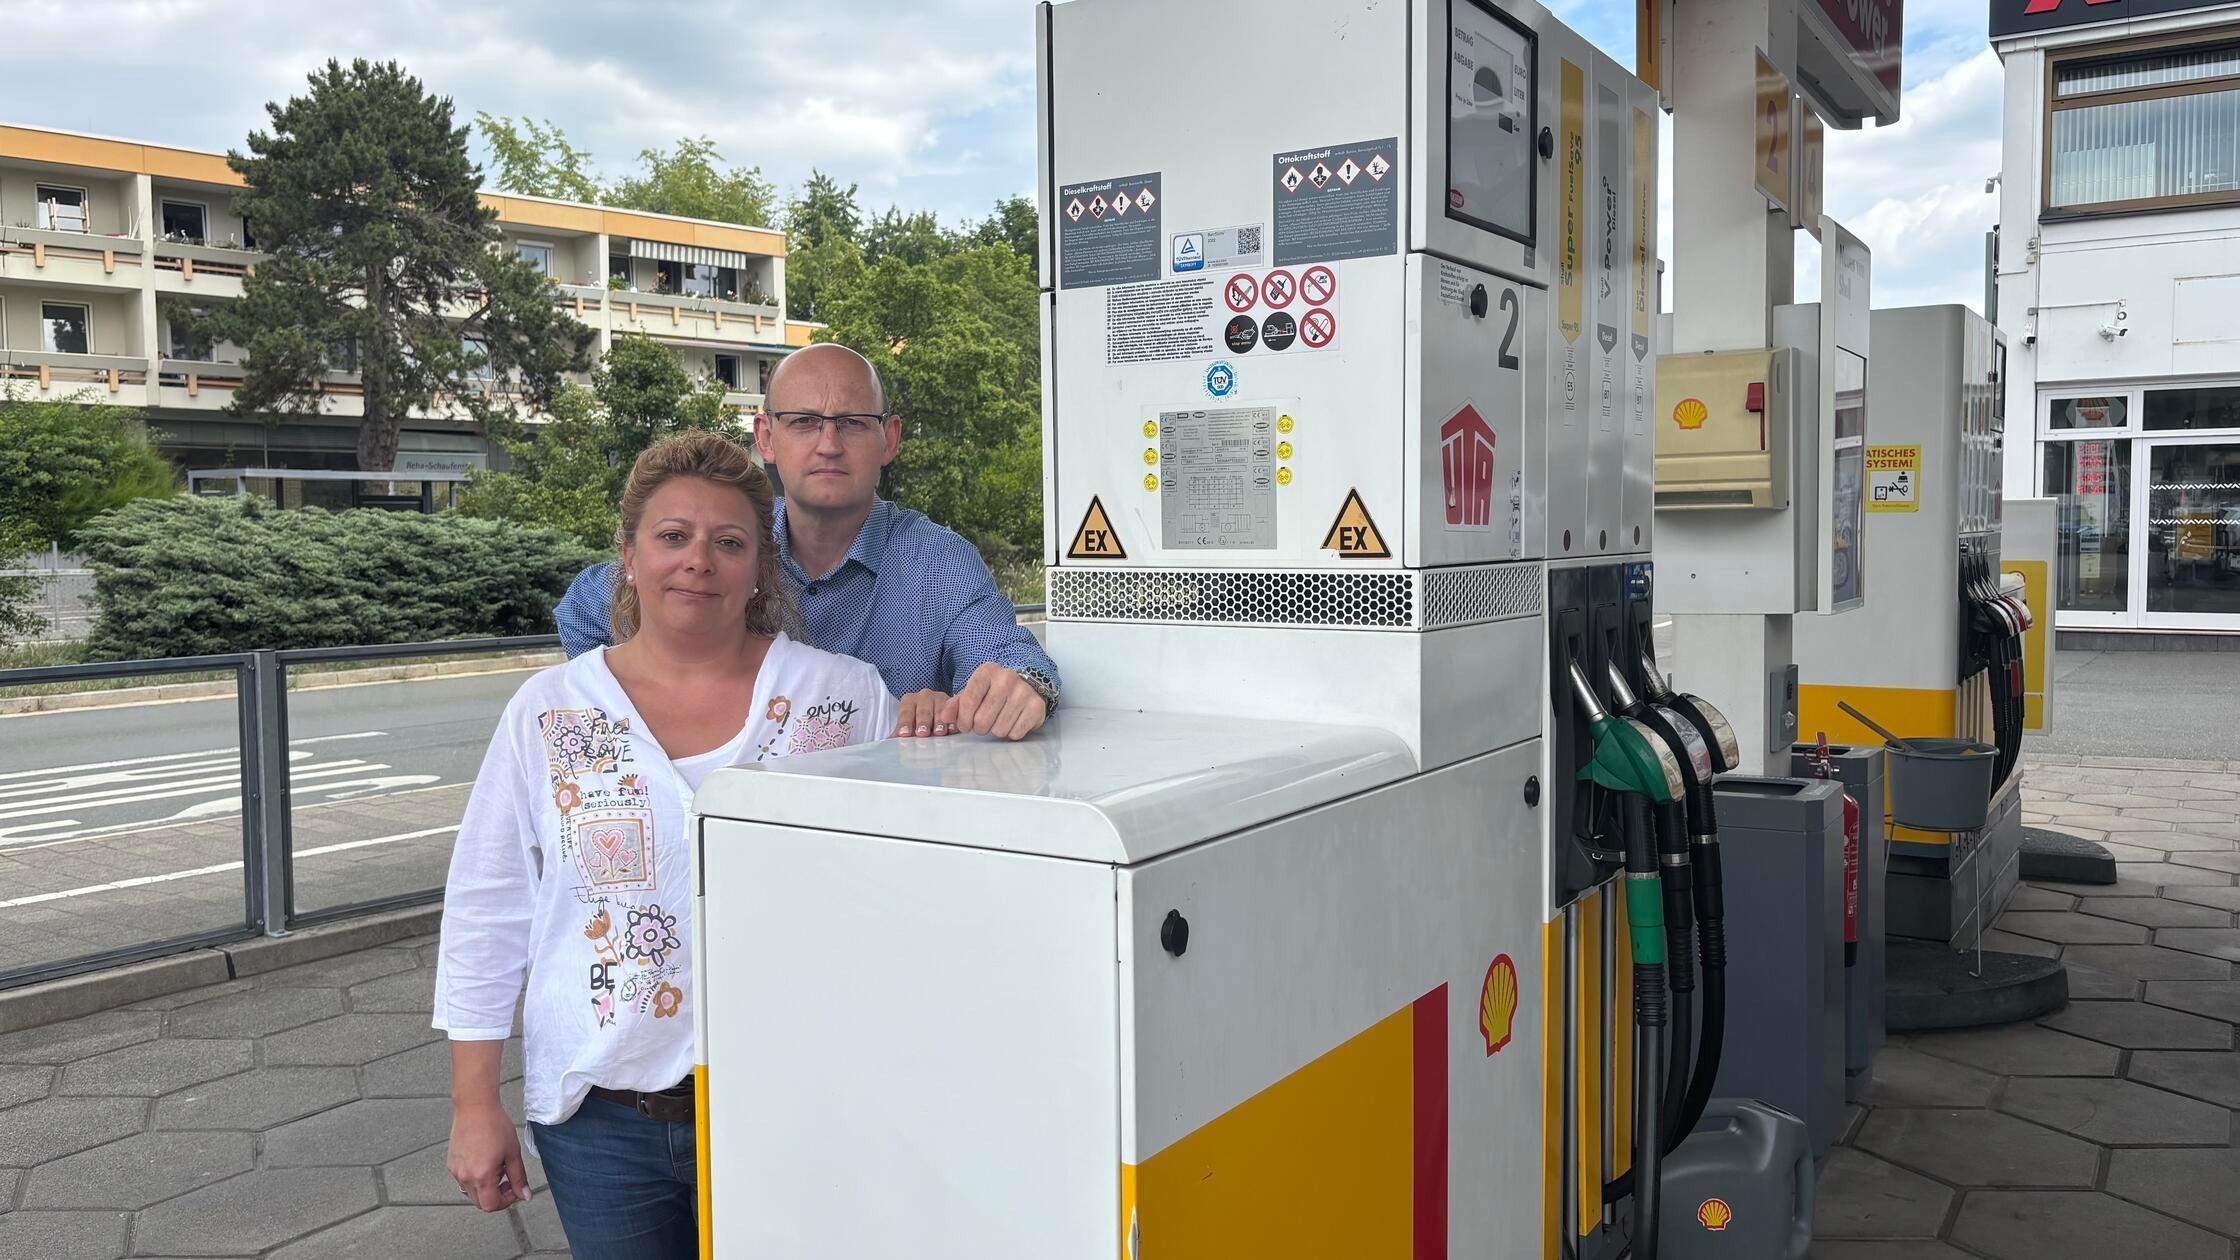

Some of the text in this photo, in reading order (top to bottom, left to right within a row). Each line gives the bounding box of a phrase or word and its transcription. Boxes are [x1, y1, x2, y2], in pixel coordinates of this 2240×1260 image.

[1454, 27, 1474, 47] BETRAG
[1454, 51, 1474, 71] ABGABE
[1514, 64, 1526, 80] EURO
[1575, 135, 1582, 165] 95
[1766, 100, 1779, 176] 2
[1278, 150, 1332, 165] Ottokraftstoff
[1807, 149, 1817, 199] 4
[1064, 182, 1113, 196] Dieselkraftstoff
[1565, 206, 1576, 286] Super
[1638, 246, 1646, 312] Diesel
[1498, 287, 1519, 371] 2
[1440, 403, 1497, 526] UTA
[1866, 448, 1916, 458] ATISCHES
[1866, 459, 1913, 468] SYSTEM!
[1084, 529, 1108, 552] EX
[1339, 526, 1368, 551] EX
[806, 696, 860, 726] enjoy
[580, 786, 649, 800] have fun!
[580, 797, 651, 811] (seriously)
[590, 961, 618, 991] BE
